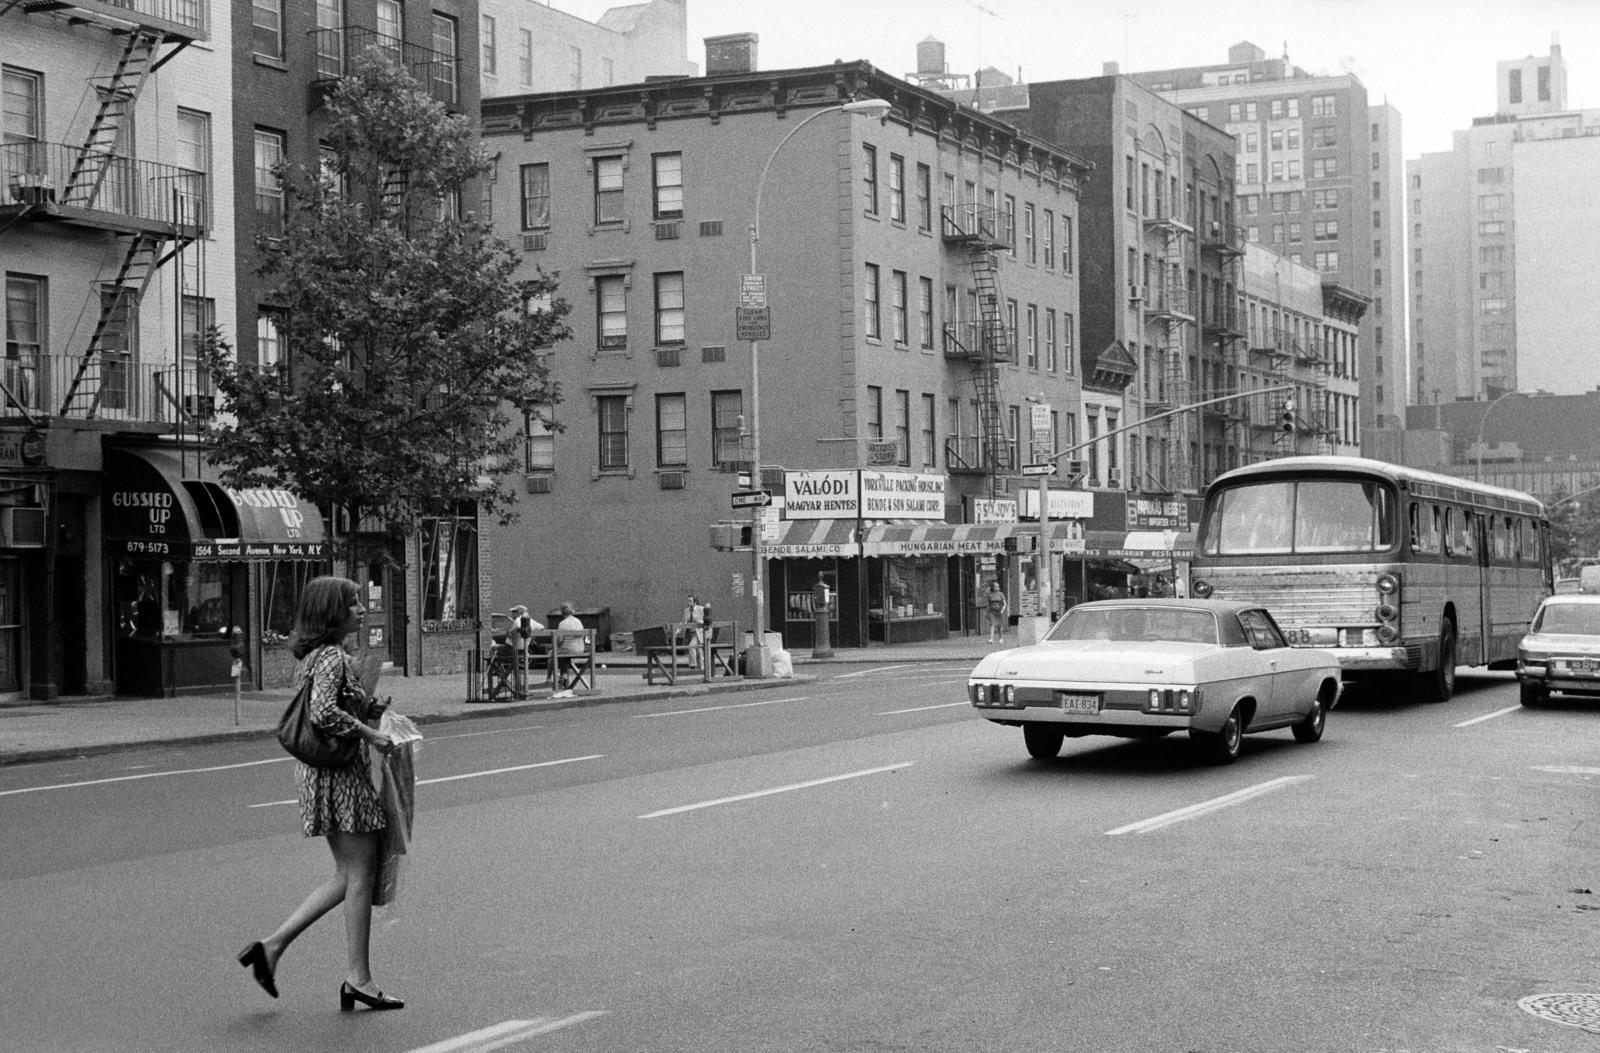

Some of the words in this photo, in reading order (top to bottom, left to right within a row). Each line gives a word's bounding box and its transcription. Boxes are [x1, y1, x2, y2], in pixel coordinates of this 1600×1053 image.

[721, 463, 726, 471] E
[793, 474, 849, 495] VALÓDI
[864, 478, 894, 492] YORKVILLE
[896, 479, 917, 492] PACKING
[112, 491, 173, 508] GUSSIED
[227, 487, 297, 508] GUSSIED
[735, 496, 746, 504] ONE
[753, 494, 766, 502] WAY
[787, 500, 821, 511] MAGYAR
[824, 500, 857, 511] HENTES
[867, 498, 887, 511] BENDE
[893, 498, 904, 511] SON
[906, 498, 925, 511] SALAMI
[149, 508, 171, 523] UP
[280, 508, 303, 528] UP
[195, 545, 212, 555] 1564
[217, 545, 240, 556] Second
[273, 544, 286, 555] New
[761, 546, 791, 554] BENDE
[795, 545, 826, 554] SALAMI
[829, 545, 840, 553] CO
[901, 542, 955, 551] HUNGARIAN
[958, 542, 982, 551] MEAT
[1107, 549, 1144, 557] HUNGARIAN
